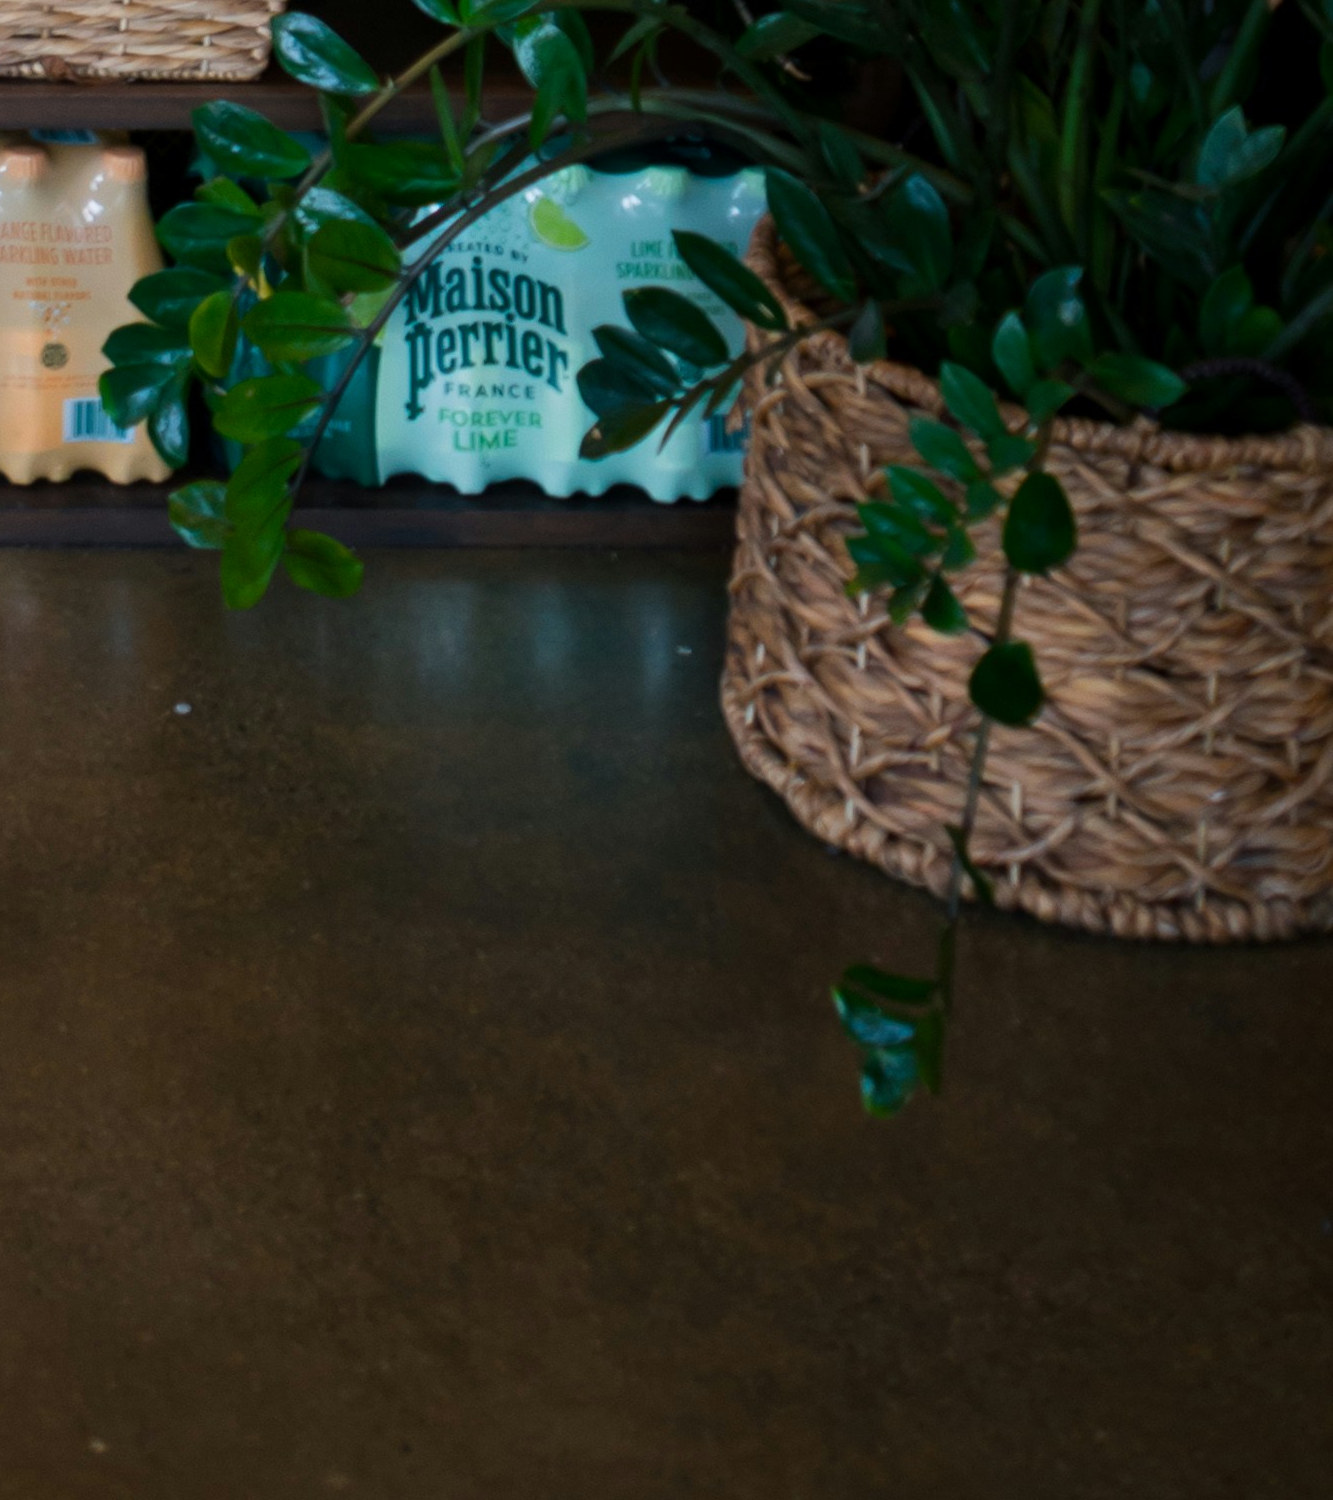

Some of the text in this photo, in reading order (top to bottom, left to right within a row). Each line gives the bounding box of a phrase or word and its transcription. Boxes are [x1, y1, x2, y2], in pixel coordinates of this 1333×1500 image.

[41, 223, 112, 243] FLAVORED
[61, 248, 113, 265] WATER
[510, 249, 528, 263] BY
[630, 241, 662, 258] LIME
[403, 256, 568, 336] Maison
[444, 380, 536, 399] FRANCE
[438, 407, 541, 428] FOREVER
[454, 429, 518, 452] LIME
